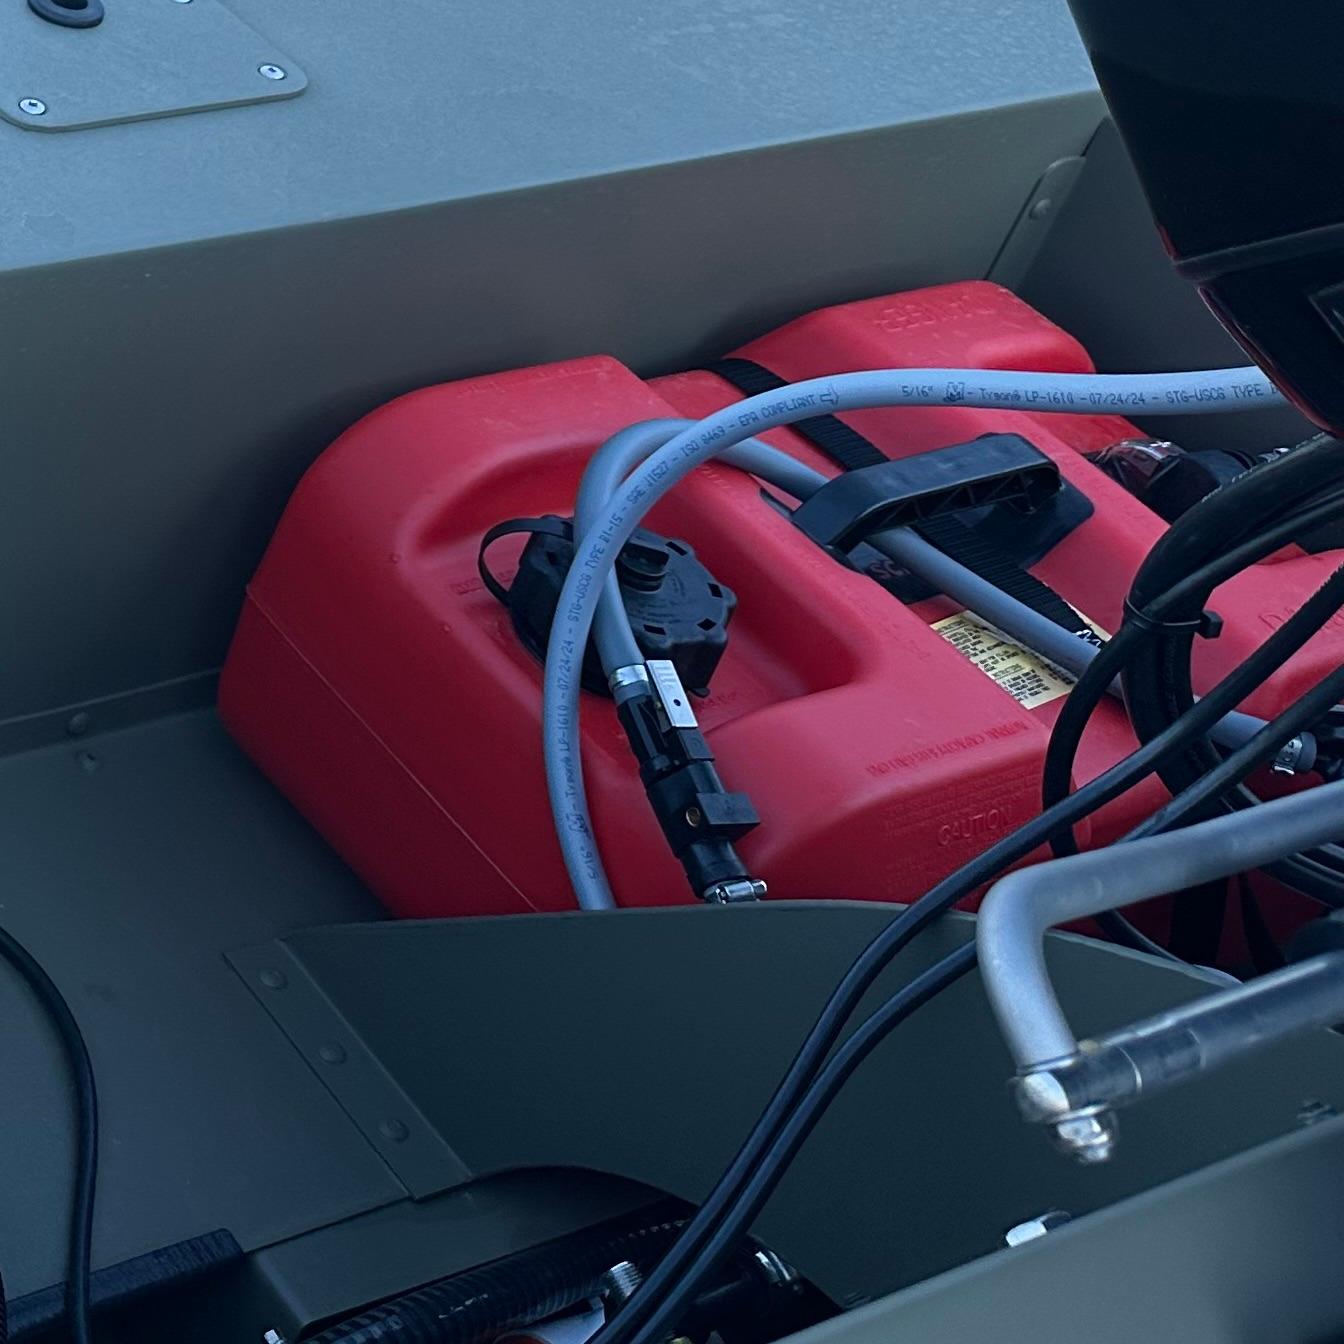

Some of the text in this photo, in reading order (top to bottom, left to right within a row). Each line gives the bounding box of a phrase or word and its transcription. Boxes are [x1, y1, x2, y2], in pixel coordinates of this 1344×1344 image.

[1230, 384, 1263, 399] TYPE
[585, 544, 605, 568] TYPE
[679, 439, 701, 457] ISO
[738, 411, 760, 427] EPA
[762, 394, 816, 418] COMPLIANT
[937, 805, 1012, 848] CAUTION
